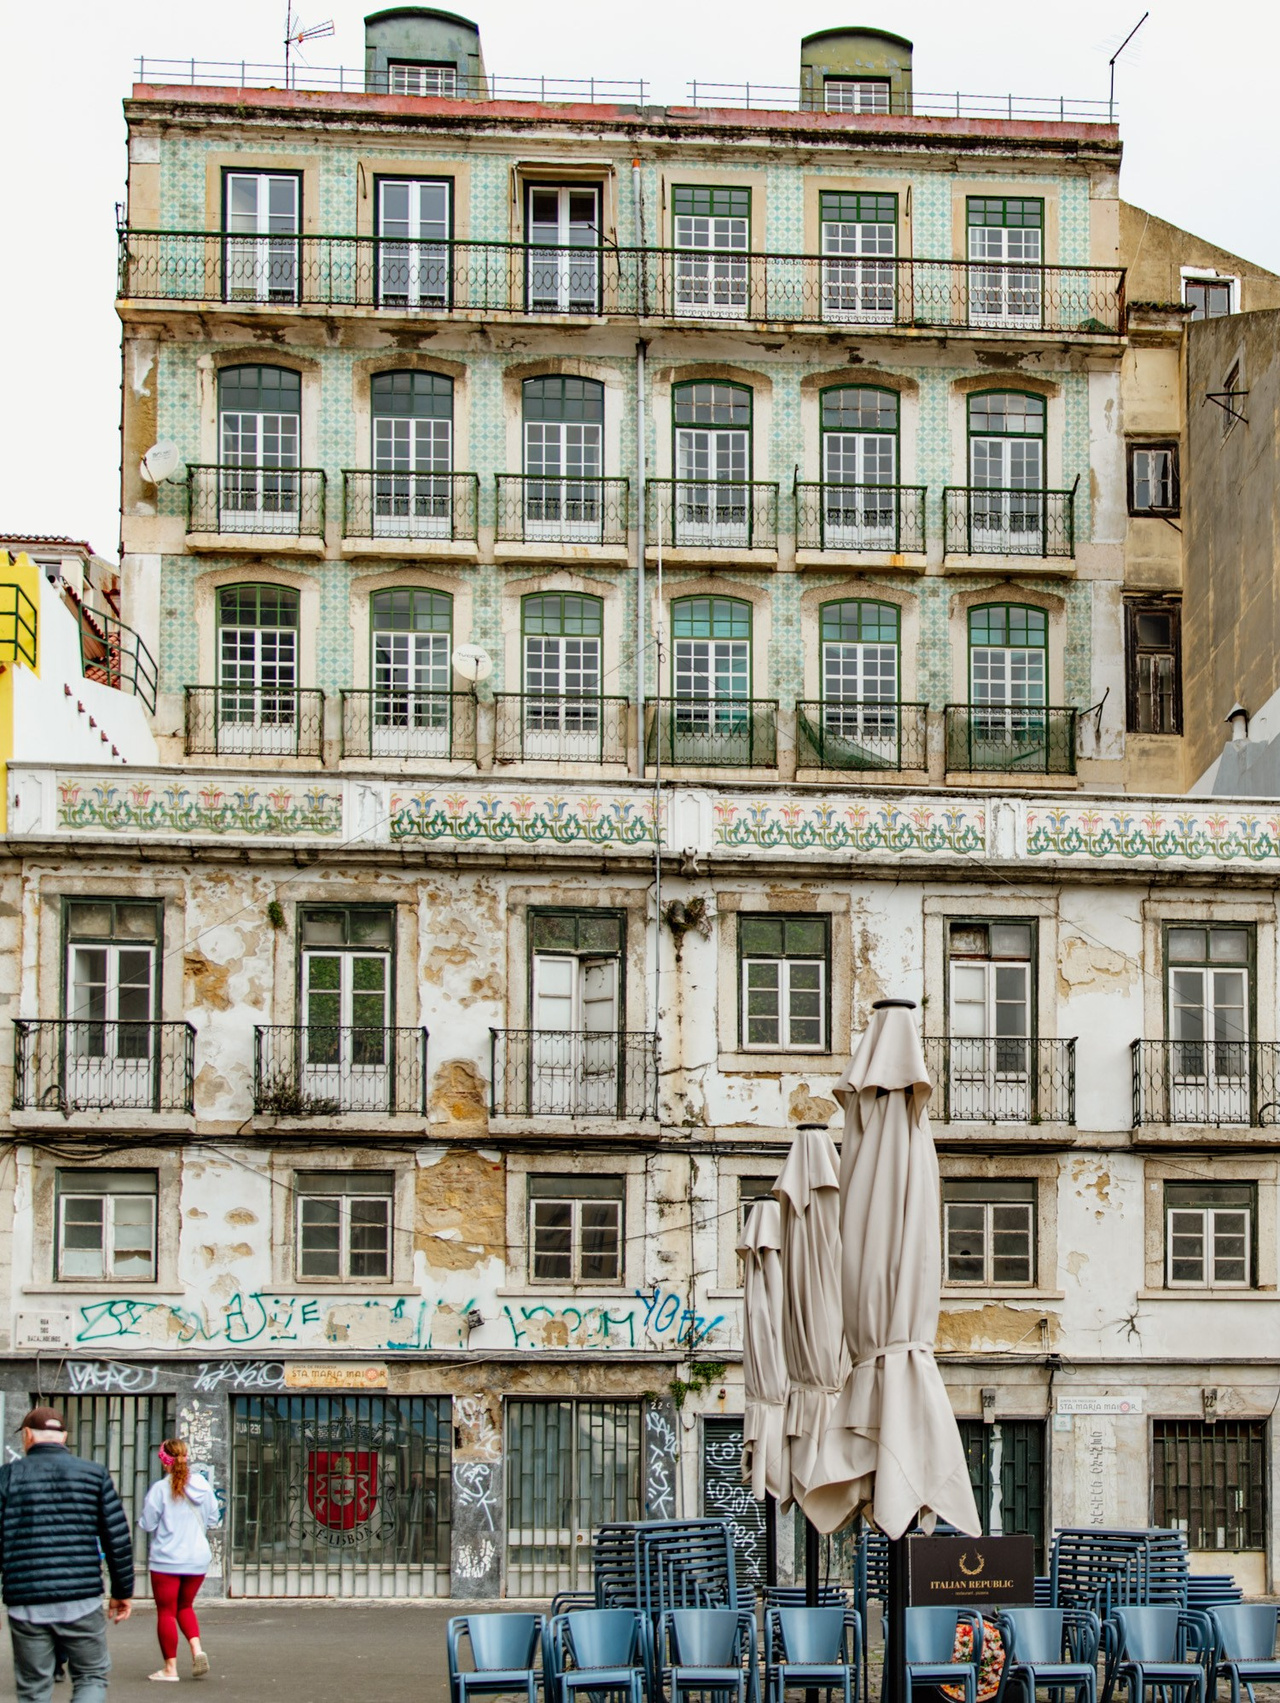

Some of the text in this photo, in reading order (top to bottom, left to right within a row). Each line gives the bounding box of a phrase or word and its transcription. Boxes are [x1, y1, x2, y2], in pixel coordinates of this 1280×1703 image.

[292, 1369, 308, 1378] STA
[311, 1369, 343, 1382] MARIA
[1060, 1403, 1073, 1411] STA
[1075, 1403, 1102, 1411] MARIA
[930, 1580, 1014, 1590] ITALIAN REPUBLIC
